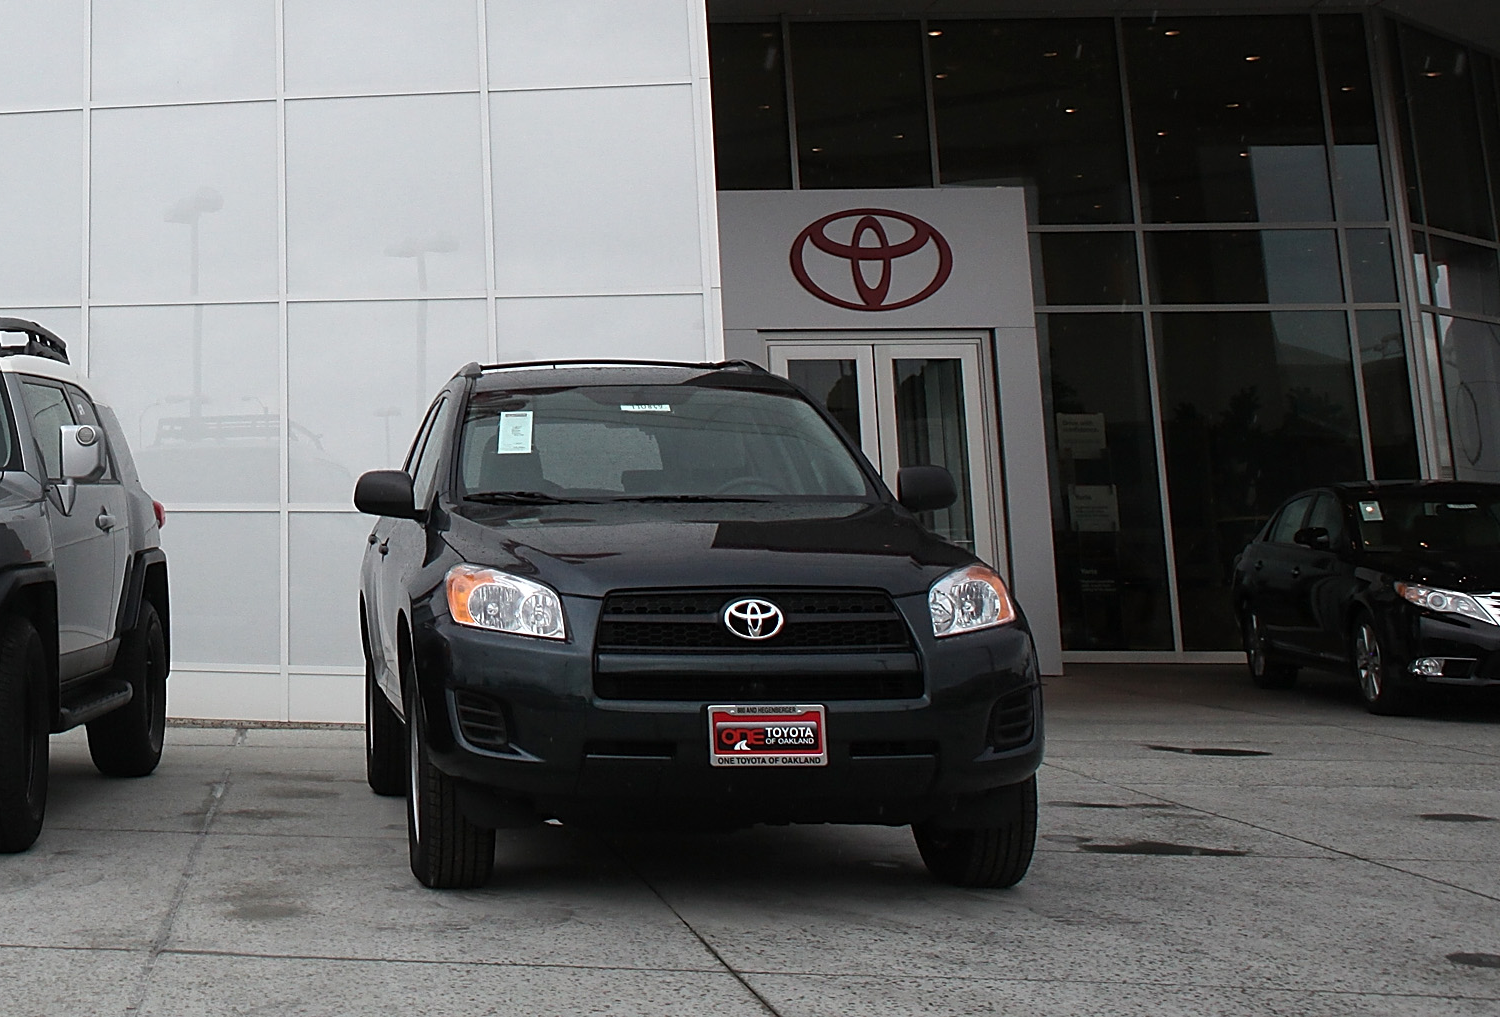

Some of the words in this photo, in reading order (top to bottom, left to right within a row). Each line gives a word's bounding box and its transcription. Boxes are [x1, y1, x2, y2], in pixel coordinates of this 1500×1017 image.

[765, 727, 814, 738] TOYOTA
[777, 737, 815, 745] OAKLAND
[717, 757, 735, 765] ONE
[736, 757, 767, 765] TOYOTA
[781, 756, 821, 764] OAKLAND
